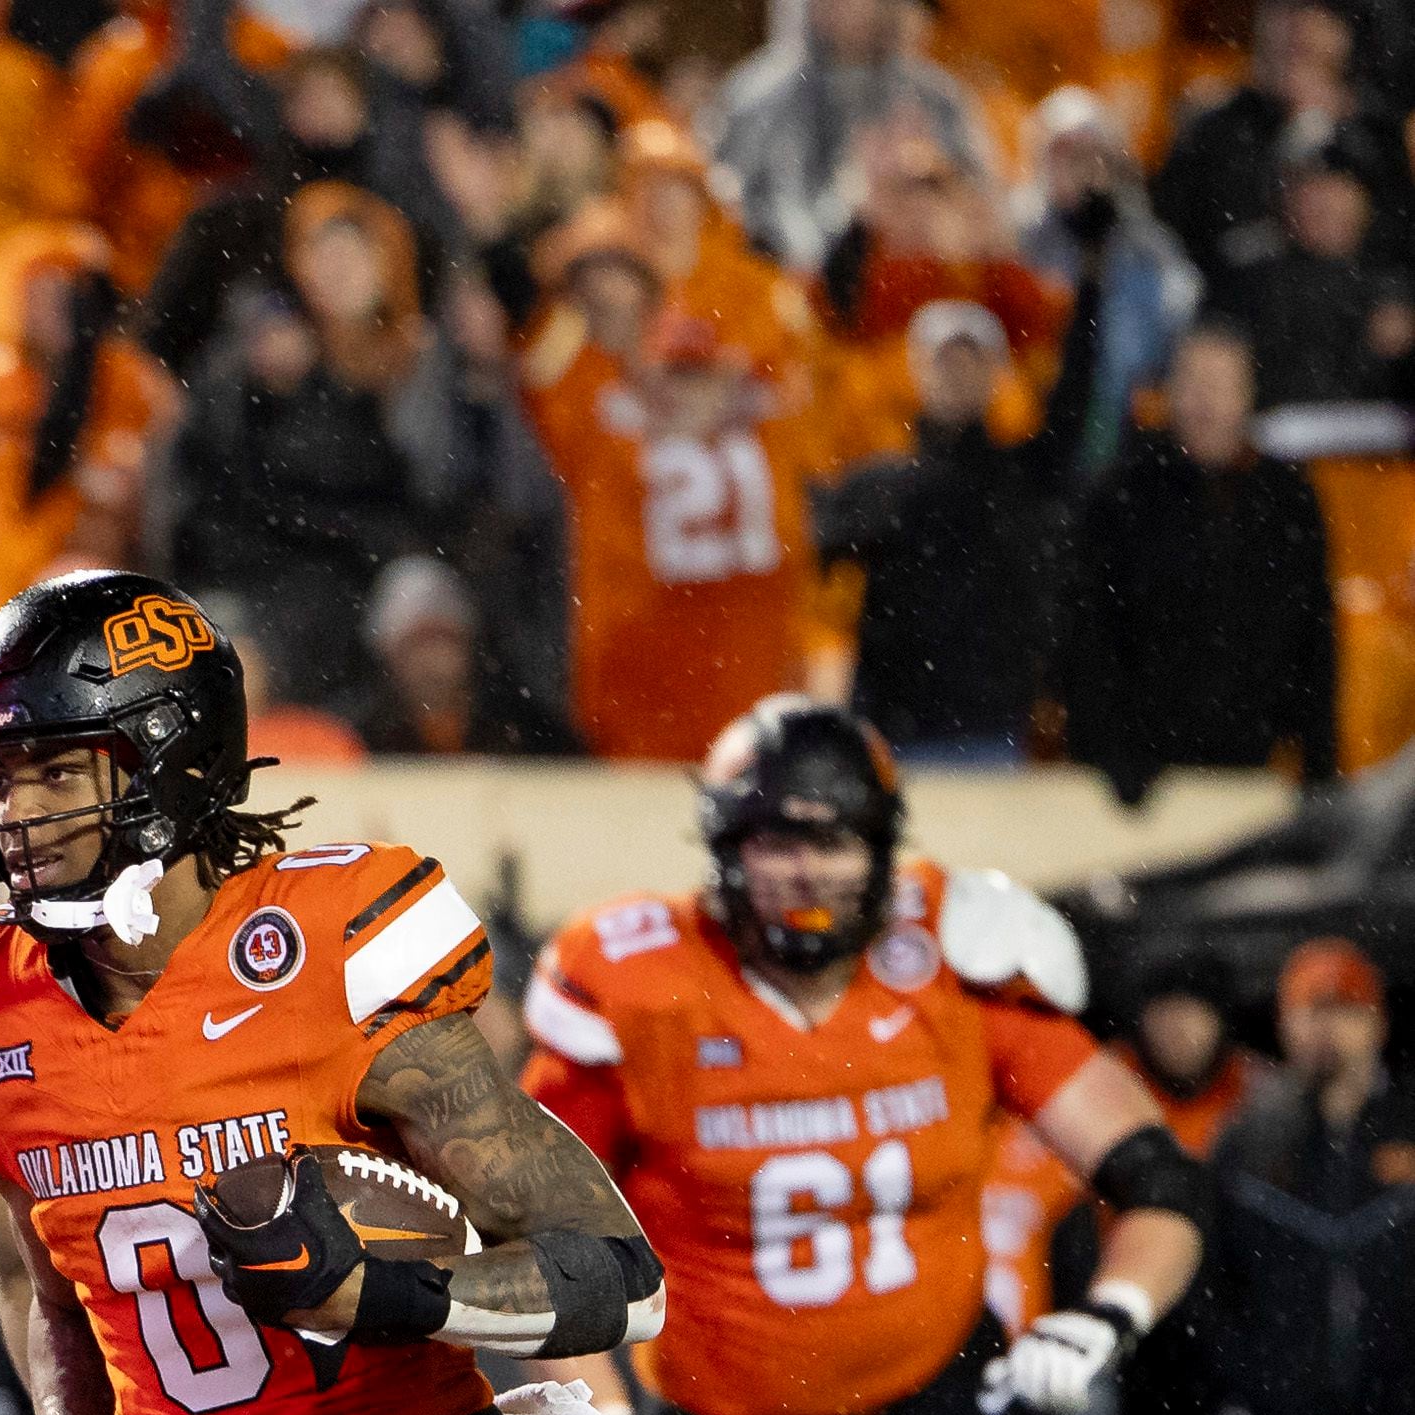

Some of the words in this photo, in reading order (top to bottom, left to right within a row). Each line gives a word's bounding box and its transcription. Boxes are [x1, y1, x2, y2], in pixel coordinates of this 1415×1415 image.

[642, 433, 783, 578] 21
[104, 594, 214, 676] OSU
[248, 929, 283, 963] 43
[17, 1130, 167, 1200] OKLAHOMA
[175, 1107, 290, 1180] STATE
[750, 1140, 918, 1307] 61
[95, 1197, 275, 1415] 0
